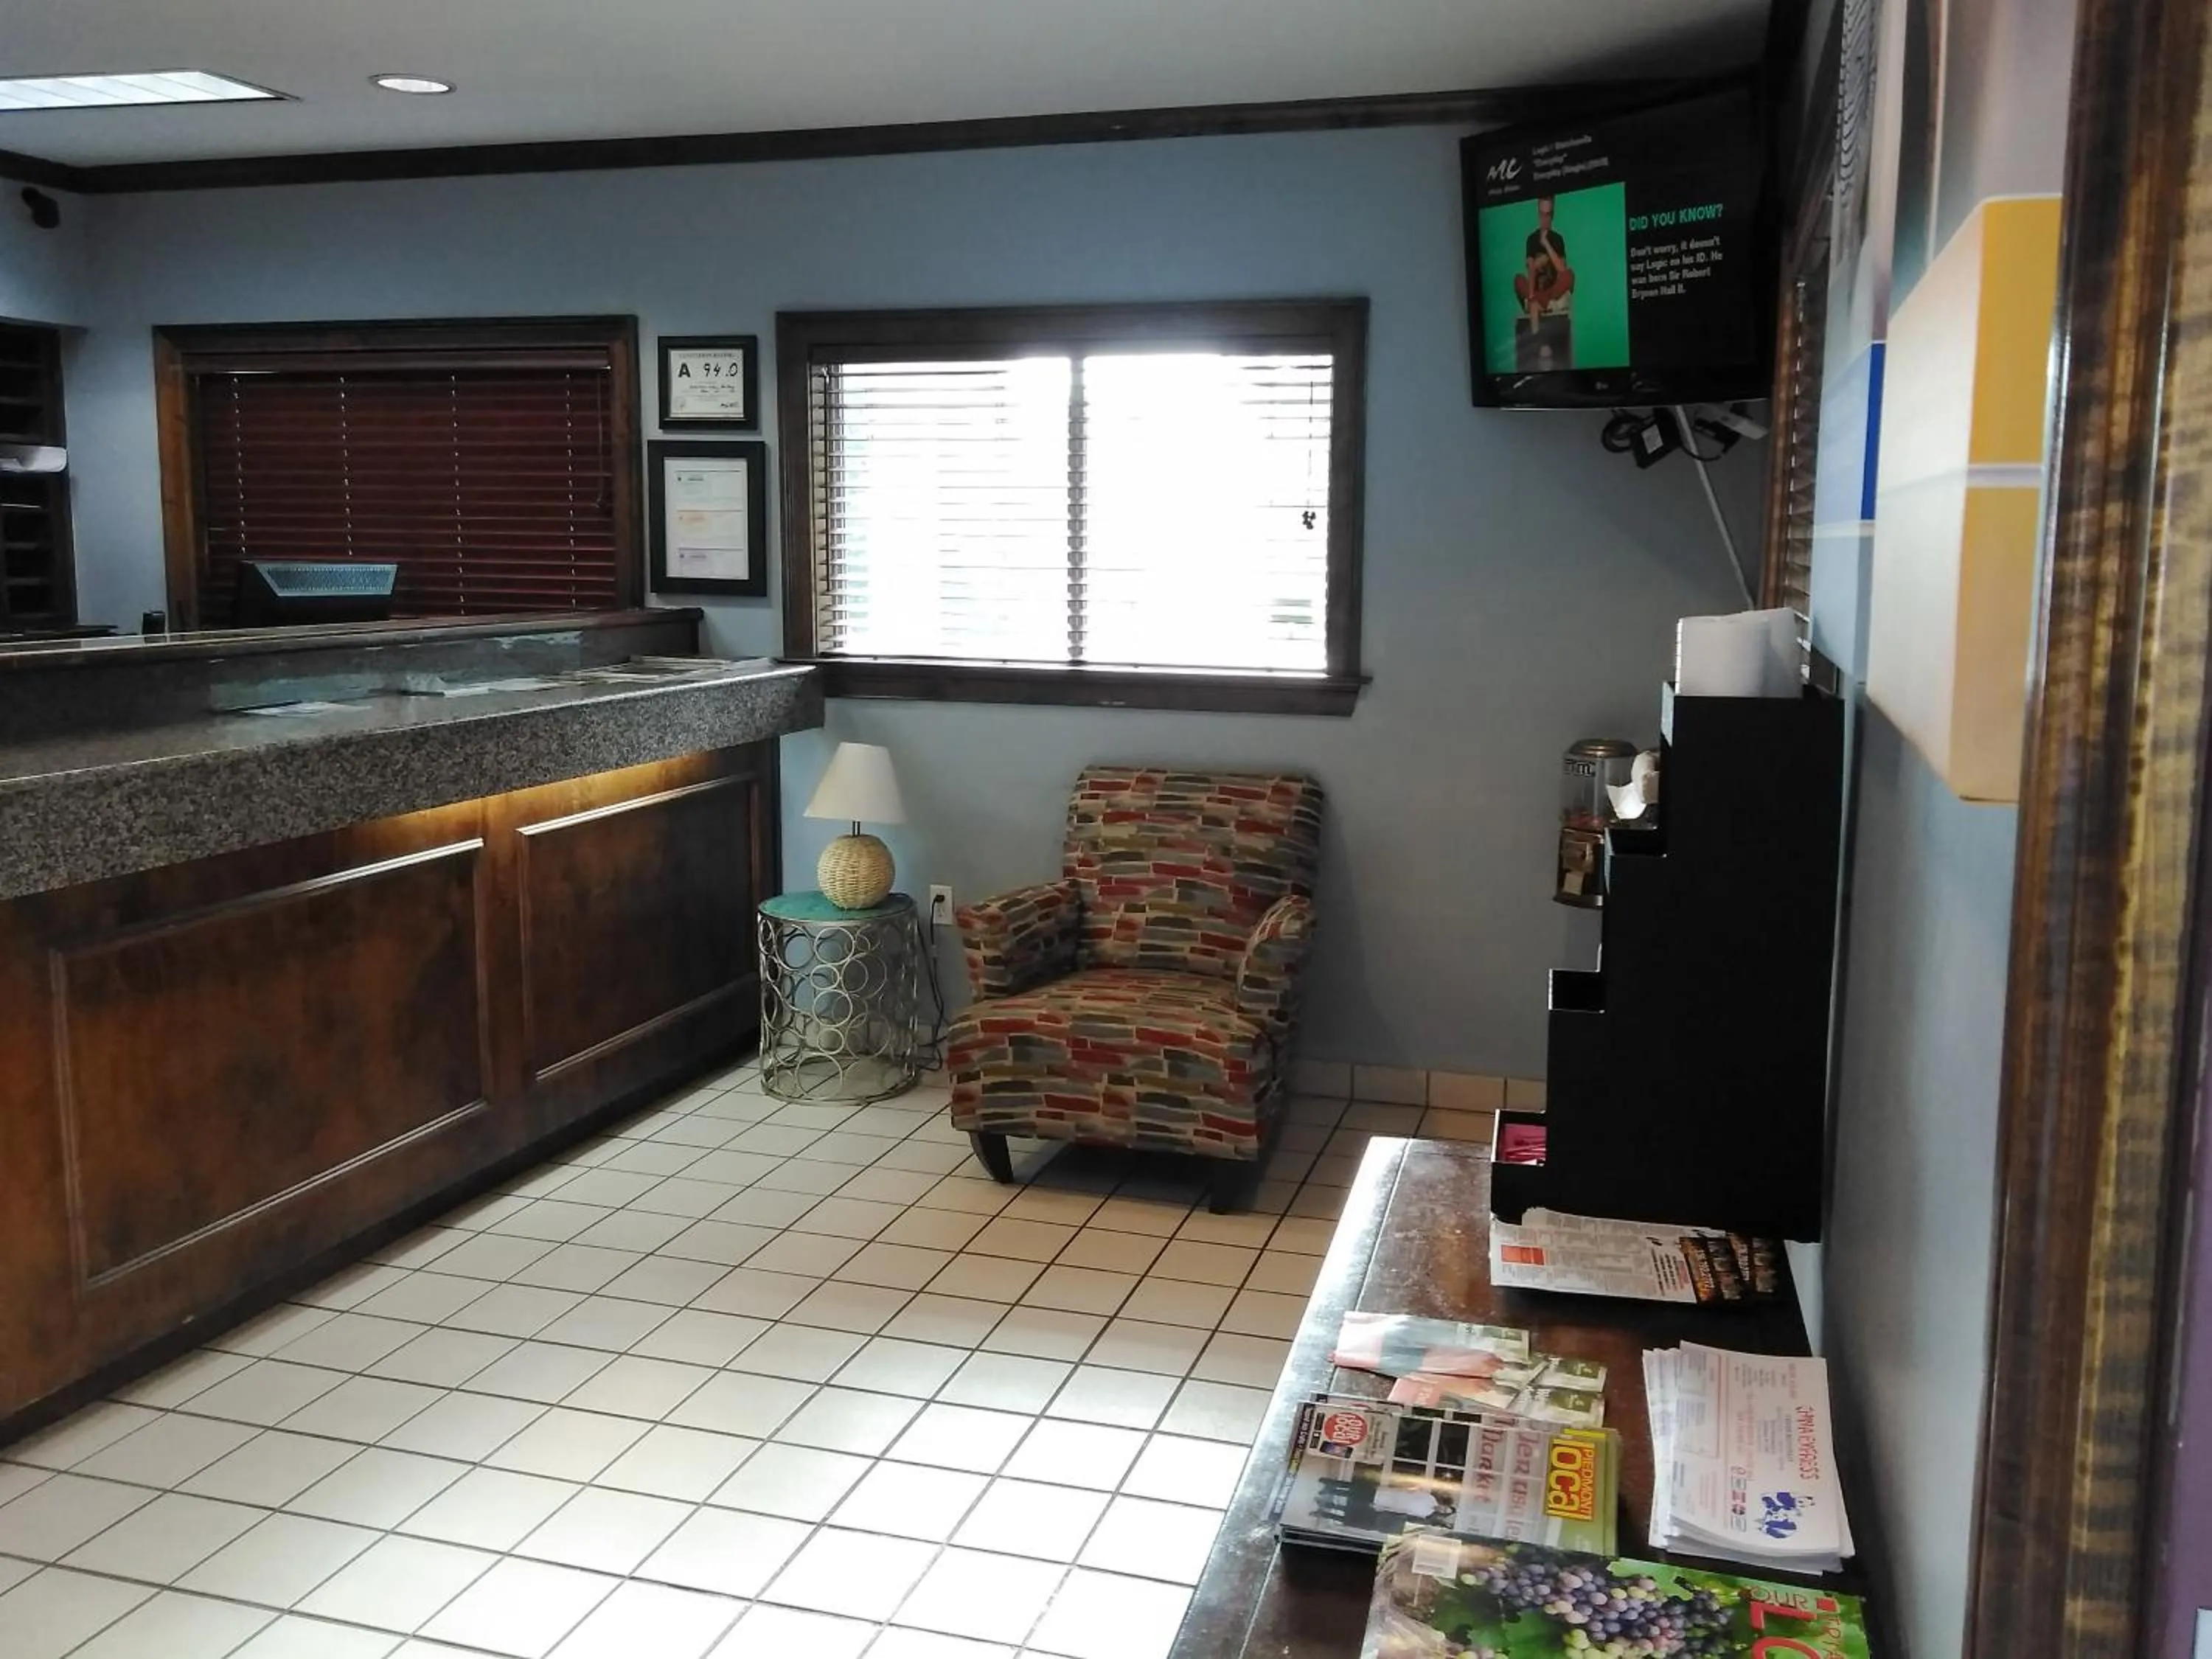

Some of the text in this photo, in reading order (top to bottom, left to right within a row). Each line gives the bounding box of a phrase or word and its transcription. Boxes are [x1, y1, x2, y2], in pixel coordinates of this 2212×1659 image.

[1629, 204, 1723, 231] DID YOU KNOW?
[678, 363, 691, 378] A
[1580, 1448, 1595, 1514] PIEDMONT
